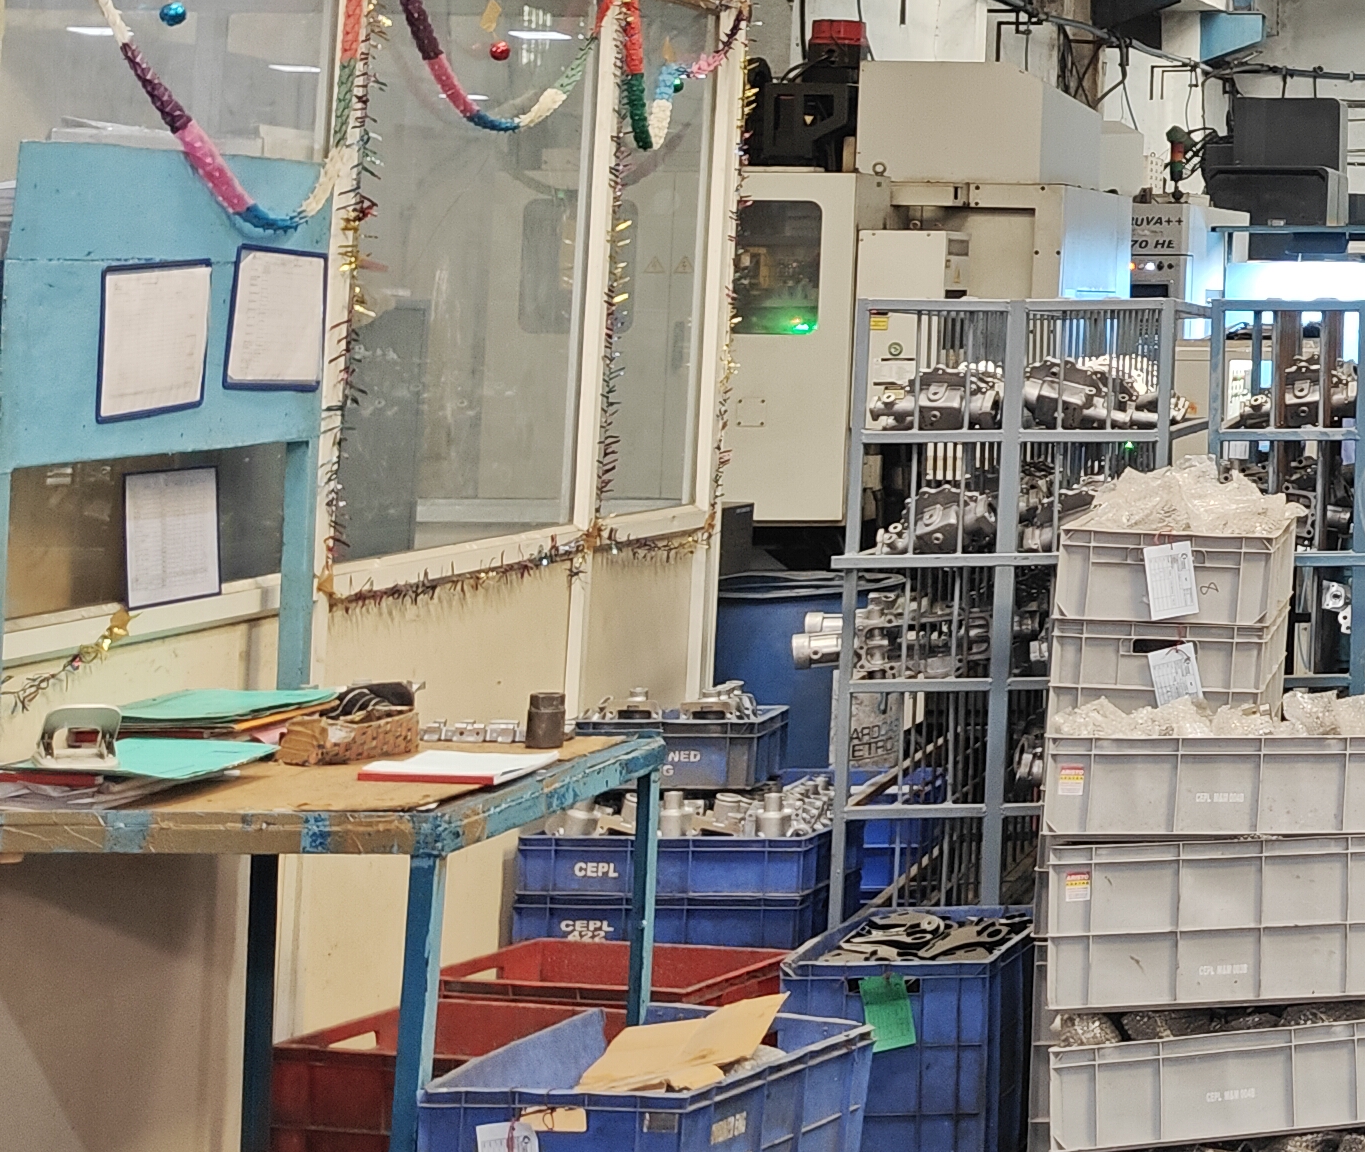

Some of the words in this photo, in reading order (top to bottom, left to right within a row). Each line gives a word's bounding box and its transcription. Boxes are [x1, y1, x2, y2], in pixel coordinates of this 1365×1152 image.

[1131, 216, 1184, 227] UVA++
[668, 750, 700, 762] NED
[662, 765, 674, 776] G
[574, 862, 618, 877] CEPL
[560, 920, 614, 932] CEPL
[567, 931, 606, 942] 422
